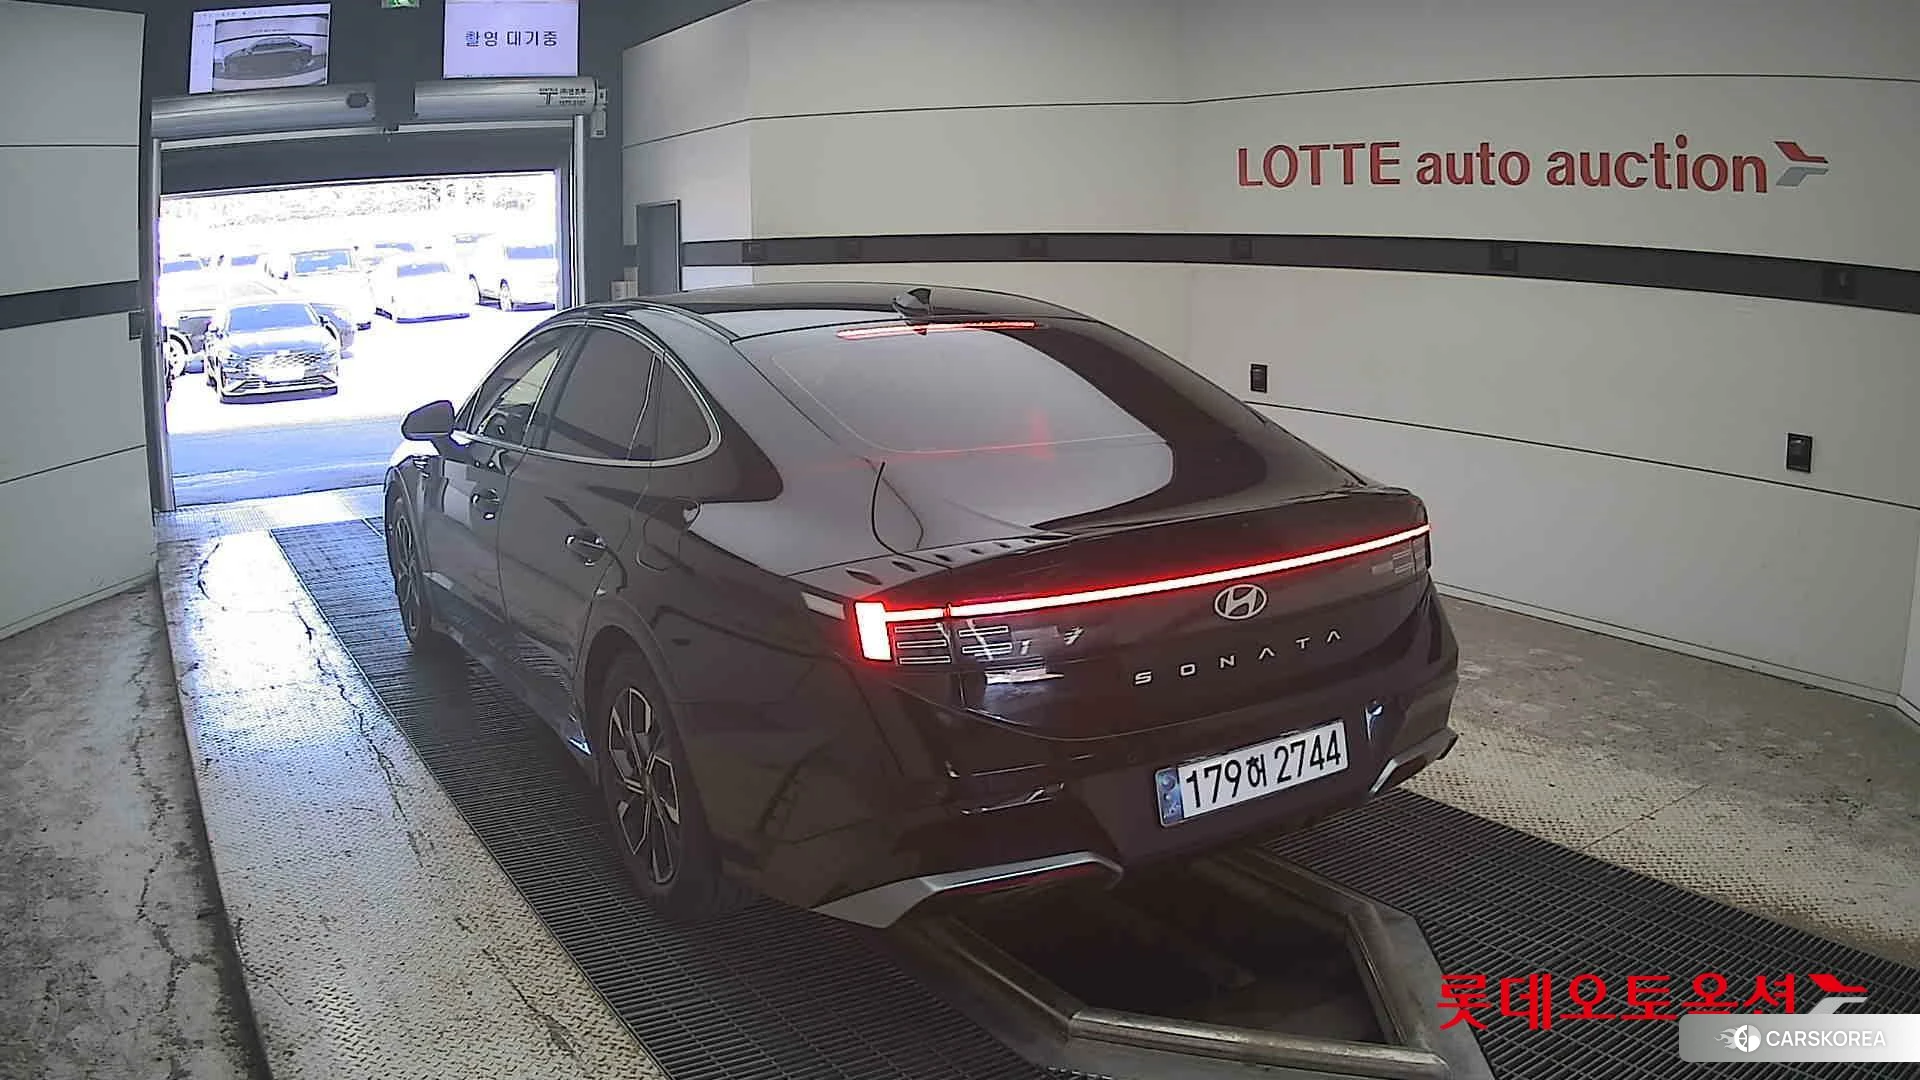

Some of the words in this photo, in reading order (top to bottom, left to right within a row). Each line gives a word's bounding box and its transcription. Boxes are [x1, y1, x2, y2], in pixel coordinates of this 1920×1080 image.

[506, 30, 558, 47] 대기중
[1236, 141, 1401, 188] LOTTE
[1416, 142, 1531, 186] auto
[1546, 134, 1768, 193] auction
[1134, 630, 1342, 685] SONATA
[1185, 754, 1268, 809] 179허
[1274, 730, 1341, 784] 2744
